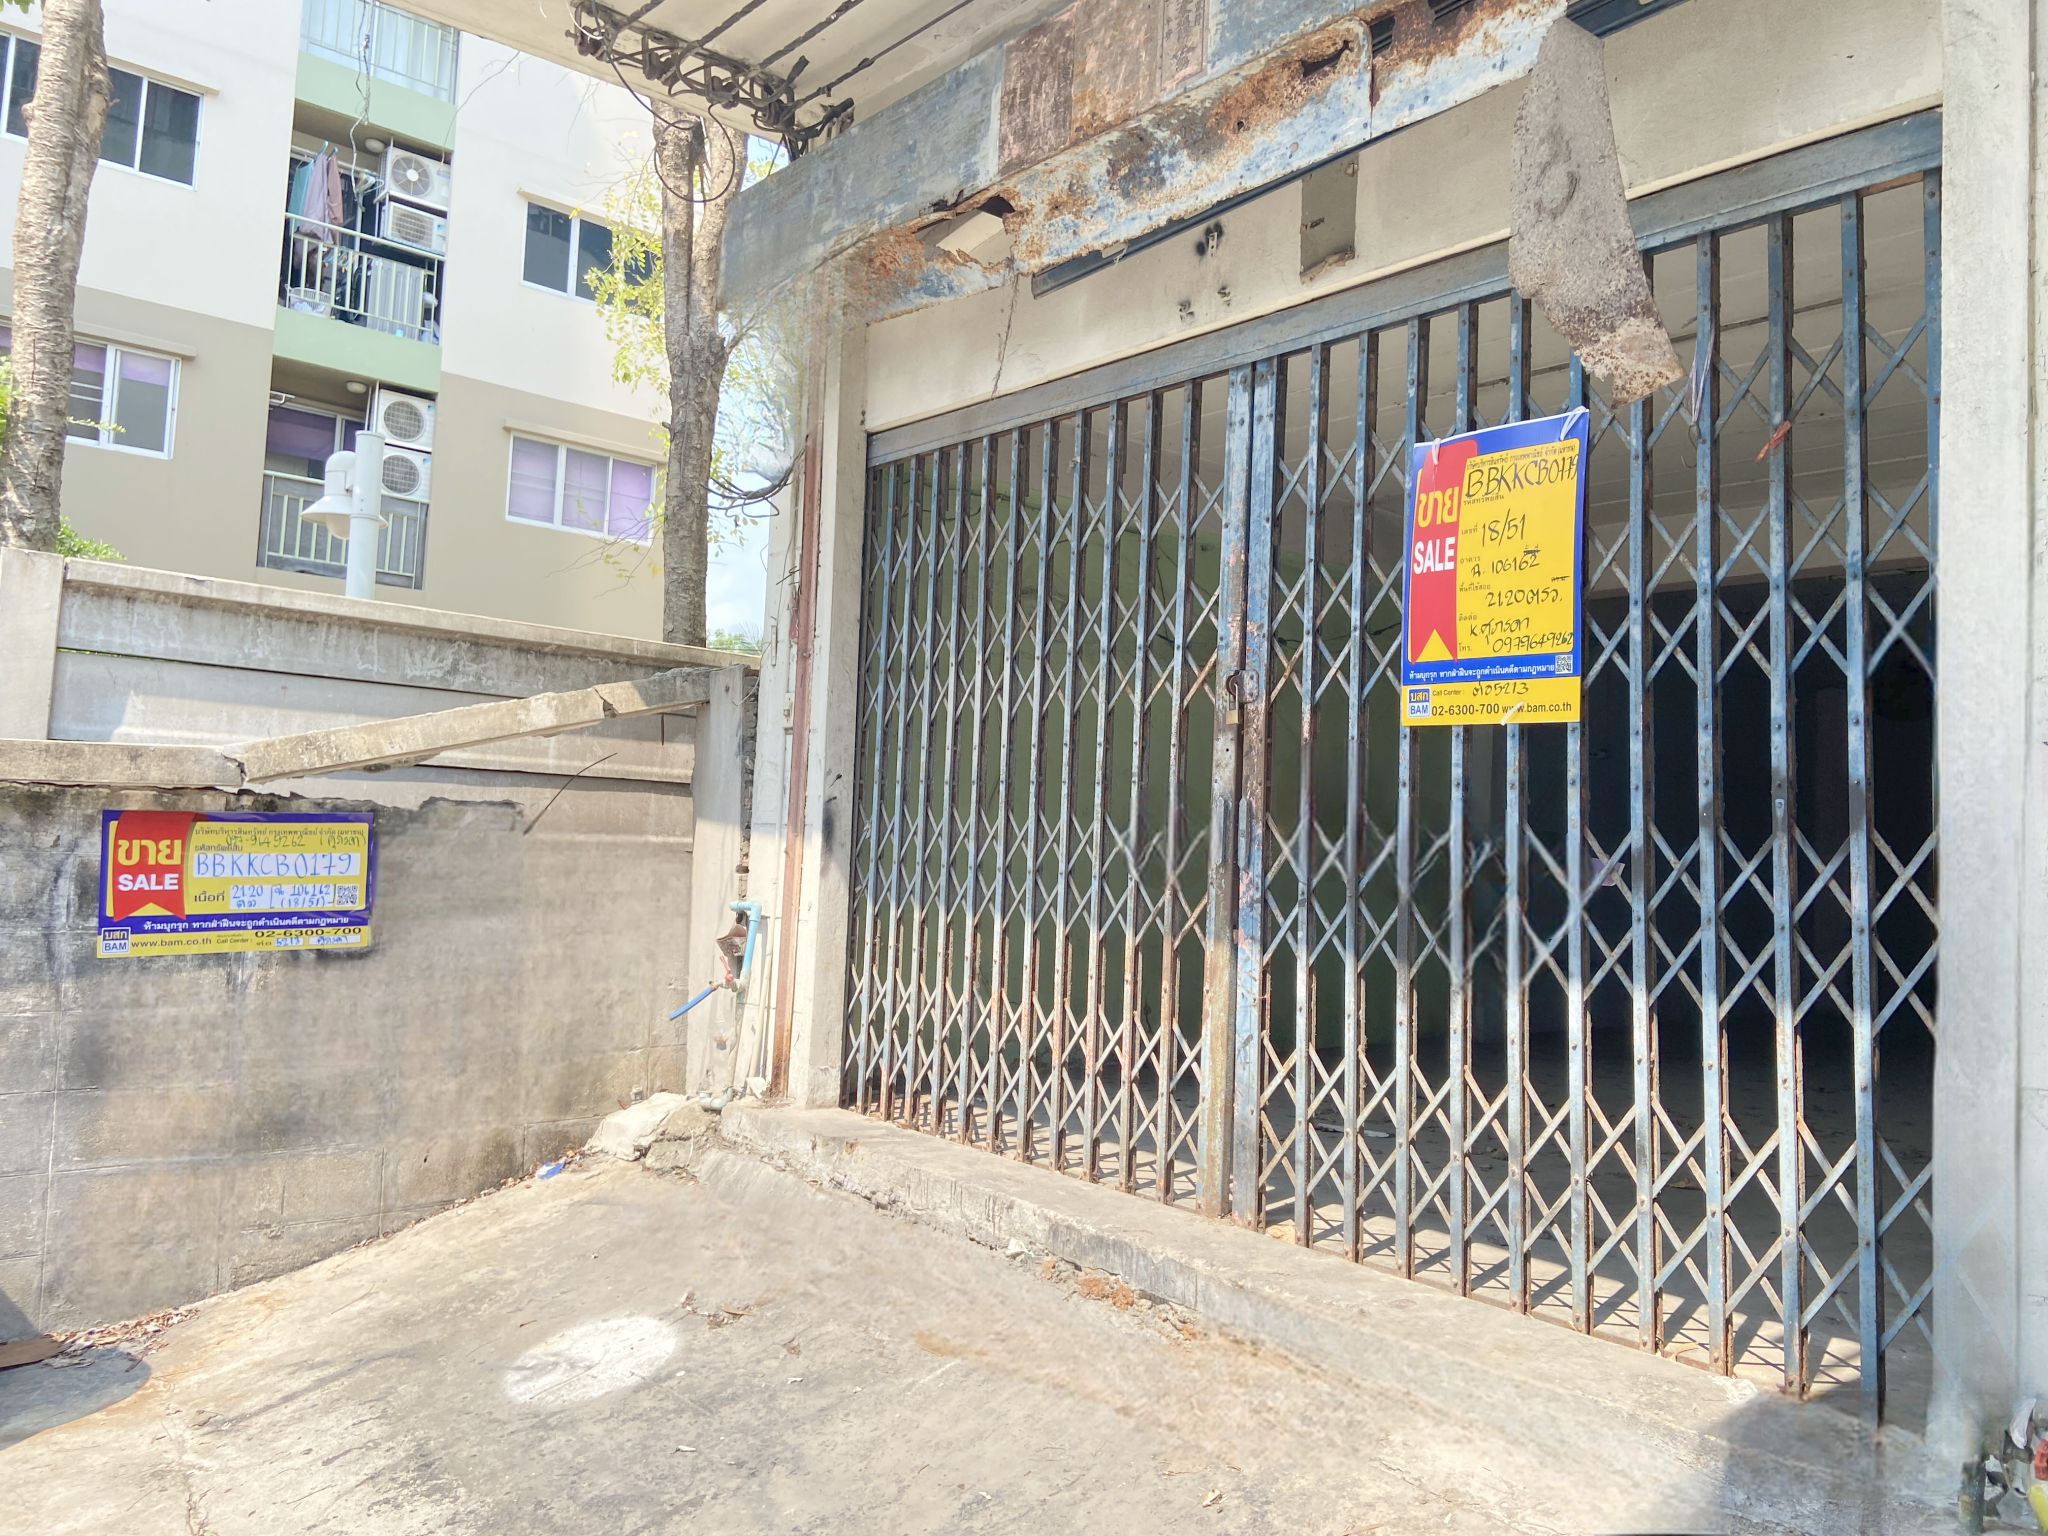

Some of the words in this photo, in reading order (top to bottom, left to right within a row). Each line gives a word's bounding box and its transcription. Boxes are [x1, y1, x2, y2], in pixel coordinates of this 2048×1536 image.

[1465, 453, 1579, 498] BBKKCB0179
[1417, 487, 1460, 528] ขาย
[1482, 508, 1526, 547] 18/51
[1413, 537, 1456, 575] SALE
[1491, 554, 1541, 575] 106162
[1409, 670, 1438, 682] ห้ามบุกรุก
[1410, 704, 1429, 715] BAM
[1431, 703, 1500, 717] 02-6300-700
[117, 839, 182, 866] ขาย
[196, 851, 353, 879] BBKKCB0179
[117, 873, 180, 891] SALE
[143, 919, 189, 931] ห้ามบุกรุก
[104, 942, 127, 951] BAM
[131, 936, 212, 948] www.bam.co.th
[254, 926, 362, 938] 02-6300-700
